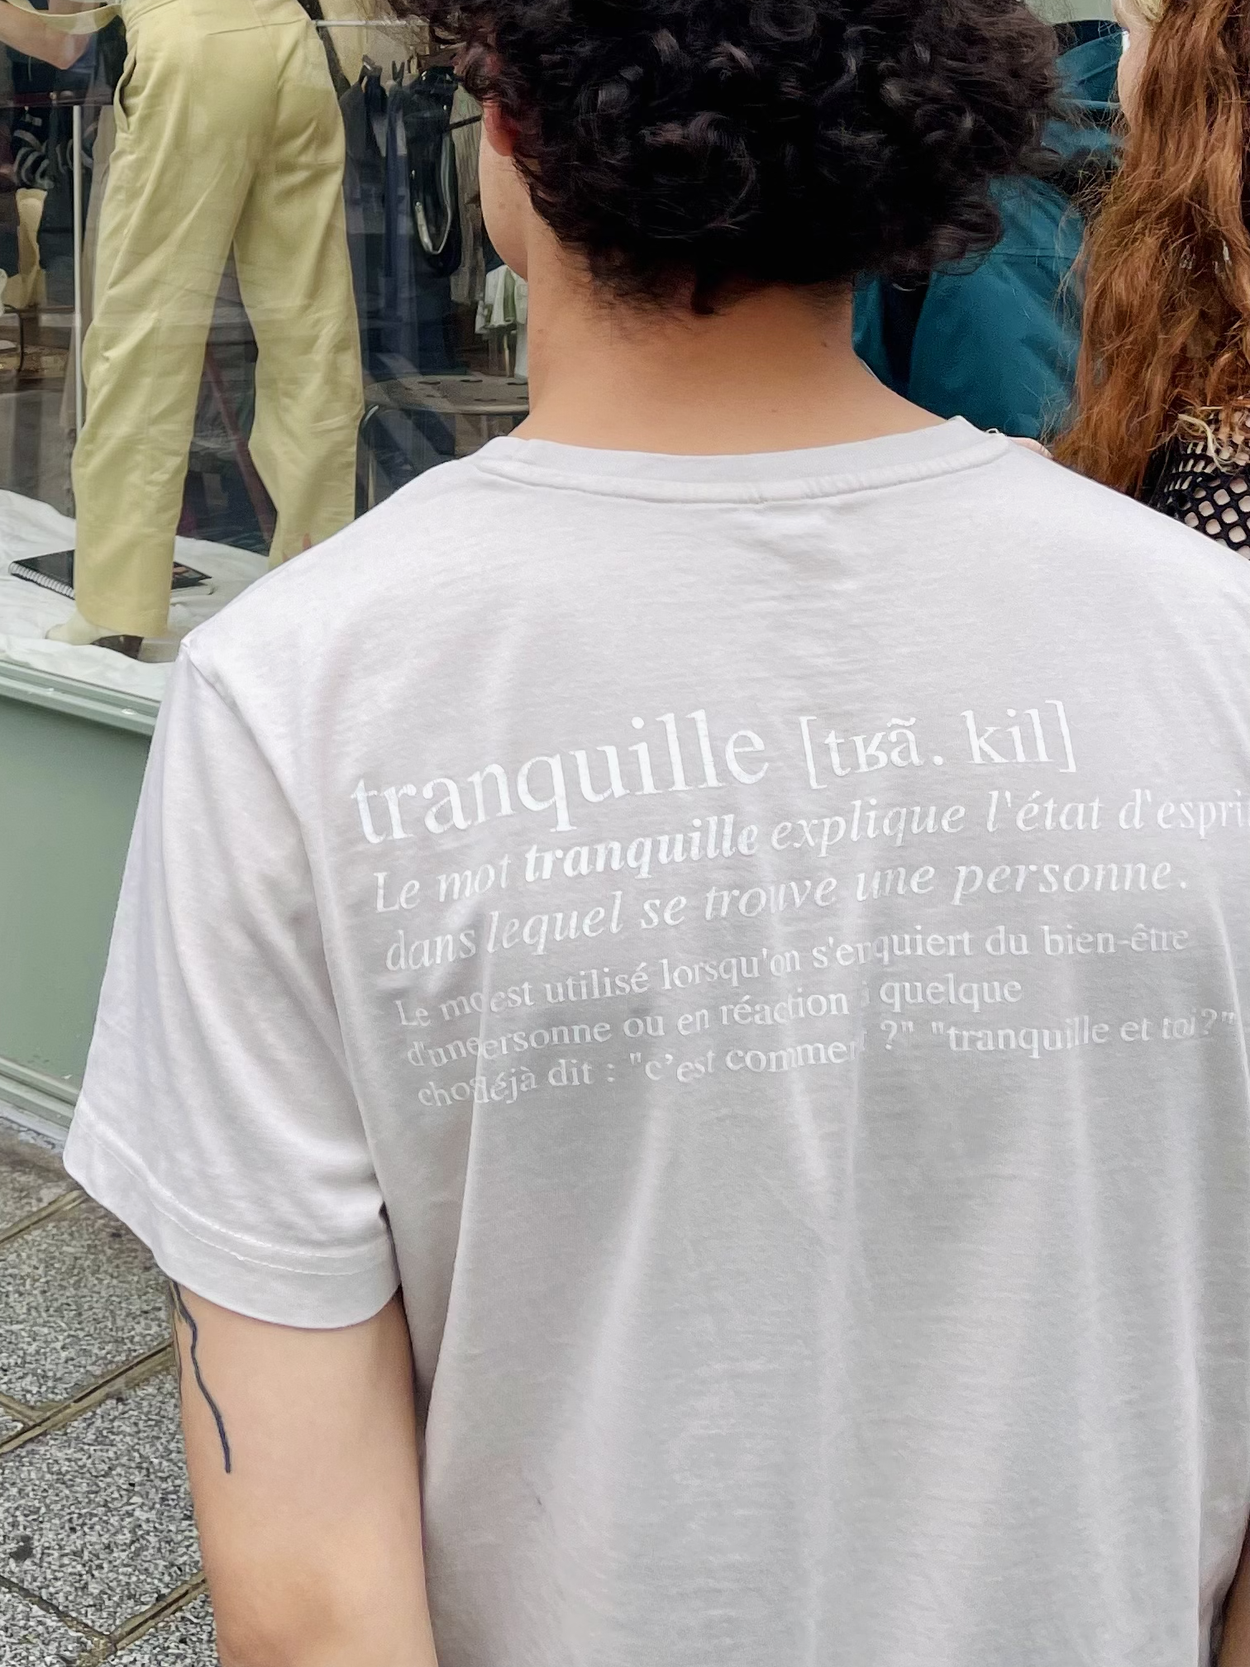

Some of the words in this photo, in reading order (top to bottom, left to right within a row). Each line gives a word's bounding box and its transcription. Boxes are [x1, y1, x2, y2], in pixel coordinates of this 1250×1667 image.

[349, 708, 769, 844] tranquille
[960, 699, 1077, 773] kil]
[373, 871, 420, 914] Le
[437, 853, 512, 904] mot
[524, 813, 760, 882] tranquille
[769, 797, 967, 858] explique
[986, 789, 1105, 833] l'état
[385, 929, 477, 972] dans
[485, 890, 624, 956] lequel
[640, 894, 688, 932] se
[704, 875, 838, 922] trouve
[855, 864, 936, 903] une
[950, 860, 1188, 906] personne.
[393, 998, 432, 1027] Le
[489, 981, 536, 1013] est
[543, 961, 649, 1004] utilisé
[658, 947, 802, 991] lorsqu'on
[984, 925, 1030, 956] du
[622, 1015, 666, 1038] ou
[676, 1008, 710, 1036] en
[719, 987, 850, 1026] réaction
[878, 972, 1023, 1014] quelque
[547, 1058, 594, 1087] dit
[1119, 1016, 1152, 1042] et
